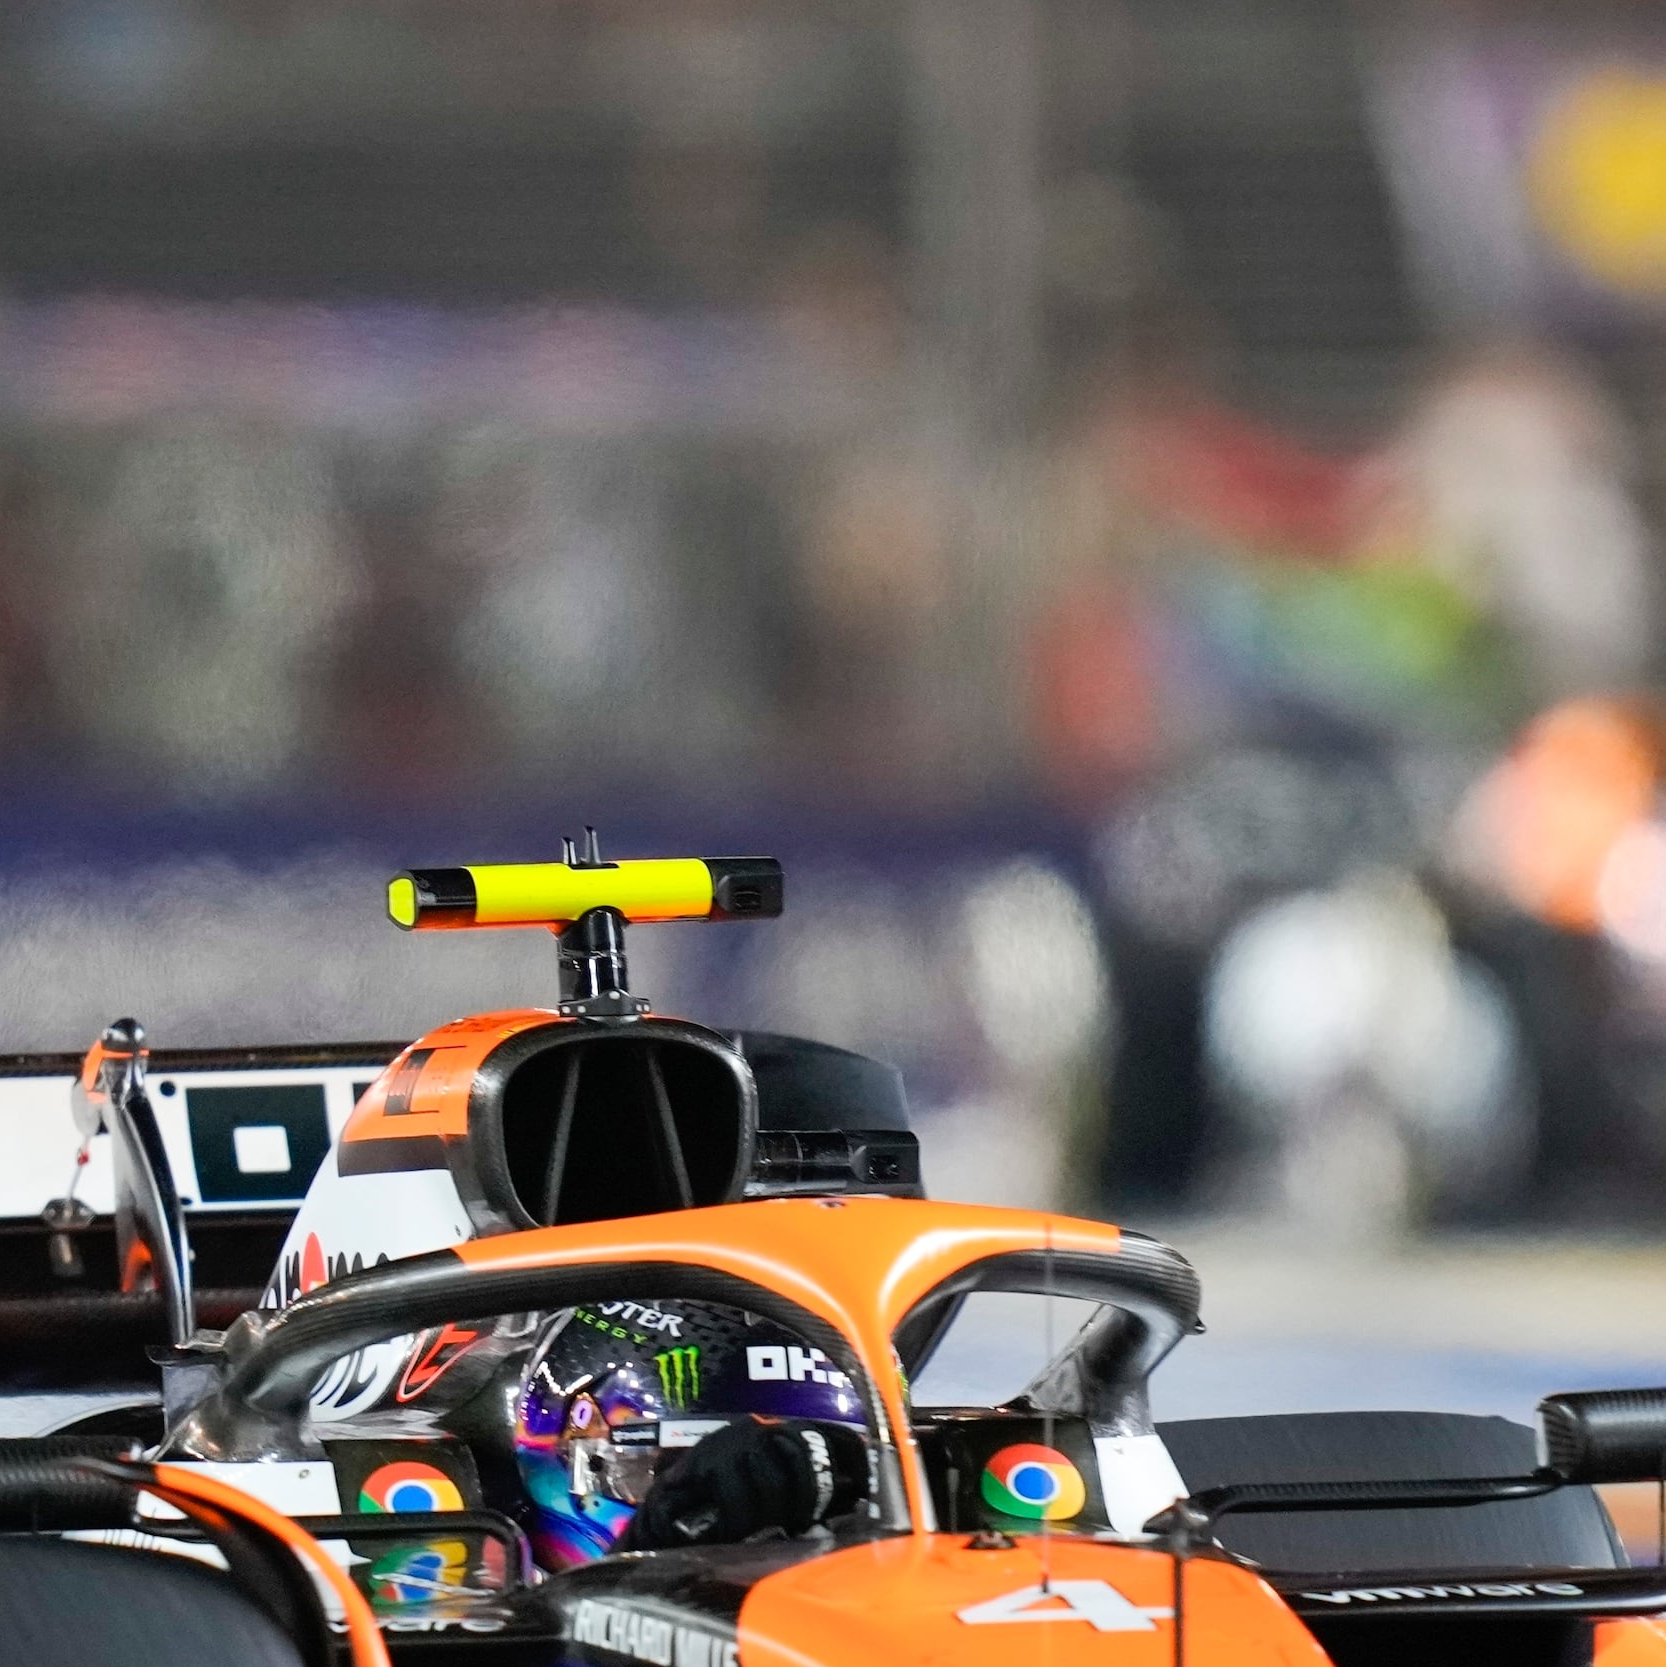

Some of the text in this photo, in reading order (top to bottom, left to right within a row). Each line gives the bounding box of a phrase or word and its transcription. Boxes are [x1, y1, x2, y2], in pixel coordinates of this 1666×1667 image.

[575, 1306, 648, 1345] NERGY
[597, 1301, 683, 1337] STER
[955, 1579, 1176, 1633] 4
[573, 1598, 673, 1667] RICHARD
